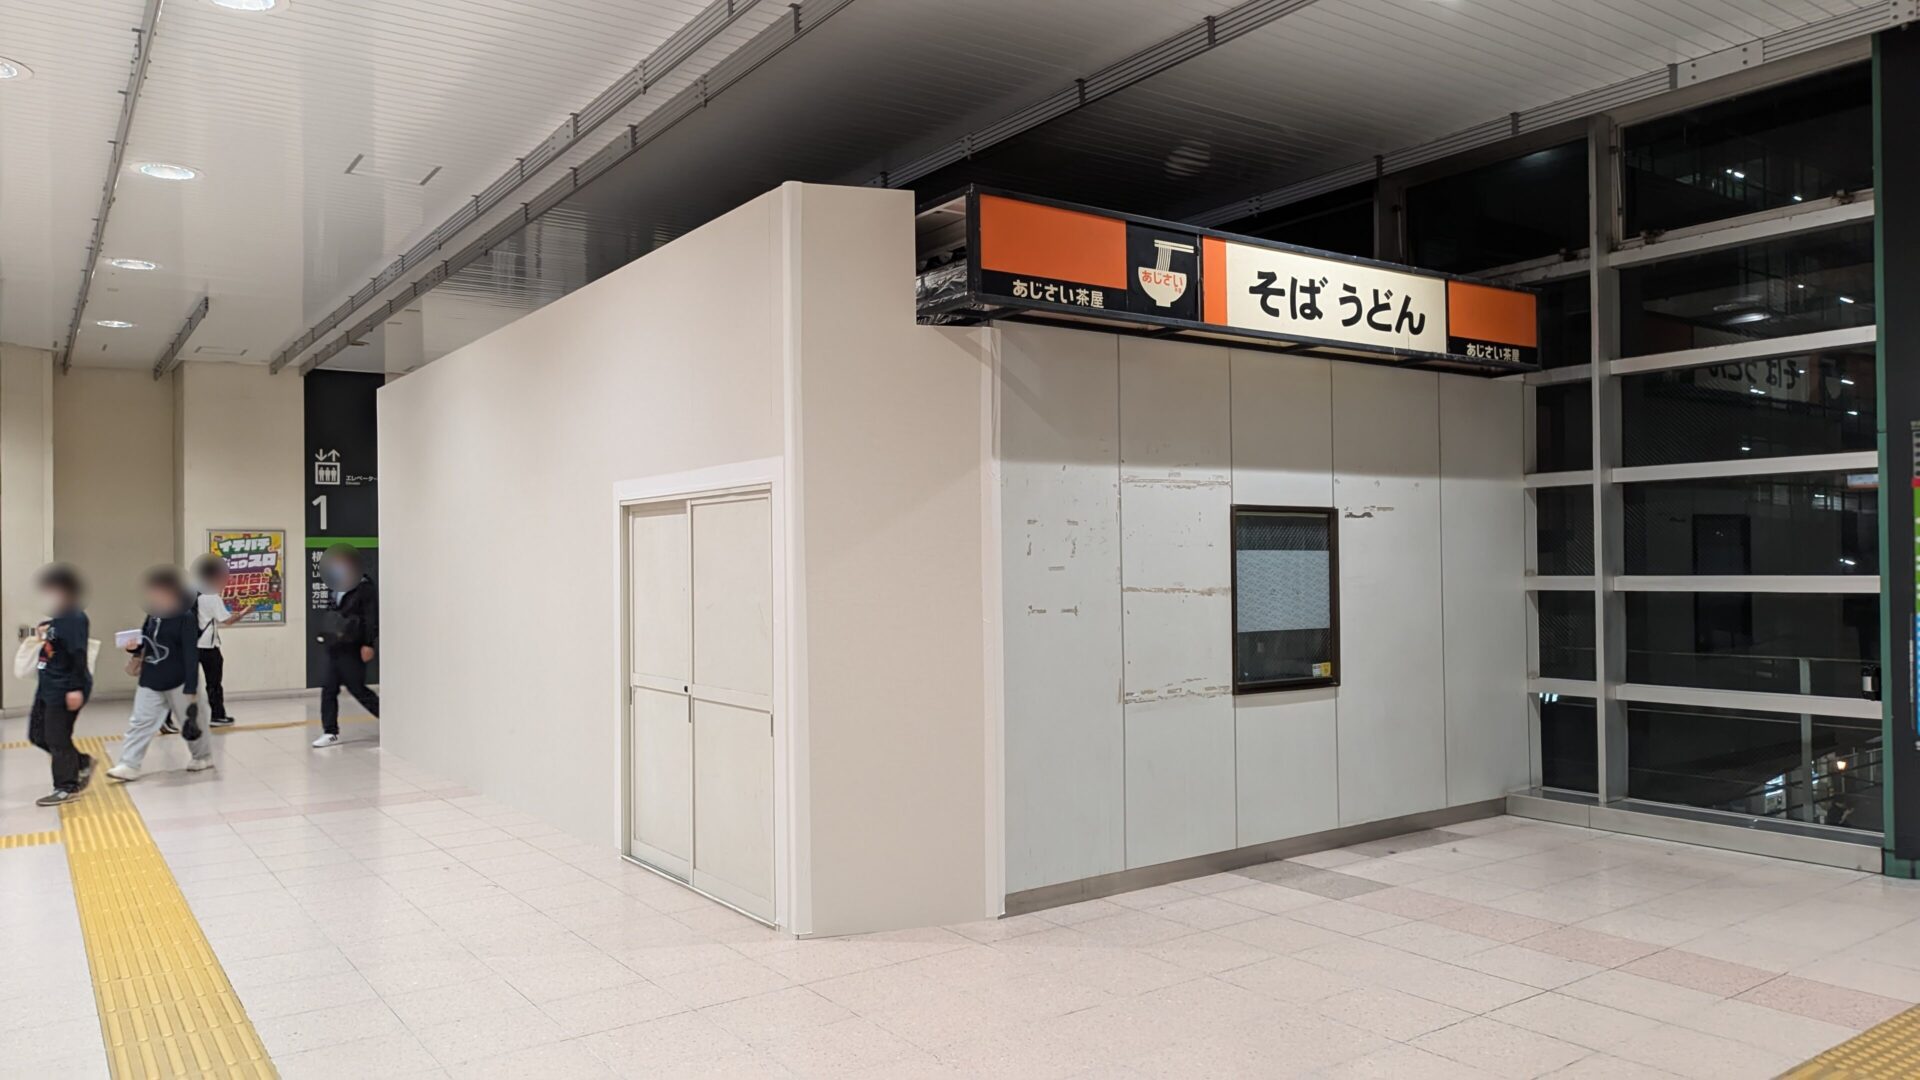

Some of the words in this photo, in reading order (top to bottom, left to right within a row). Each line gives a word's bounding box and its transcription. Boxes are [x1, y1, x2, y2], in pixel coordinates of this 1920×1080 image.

[1142, 270, 1183, 287] あじさい
[1012, 279, 1104, 309] あじさい茶屋
[1249, 271, 1328, 321] そば
[1339, 283, 1426, 336] うどん
[1466, 343, 1521, 362] あじさい茶屋
[312, 495, 327, 530] 1
